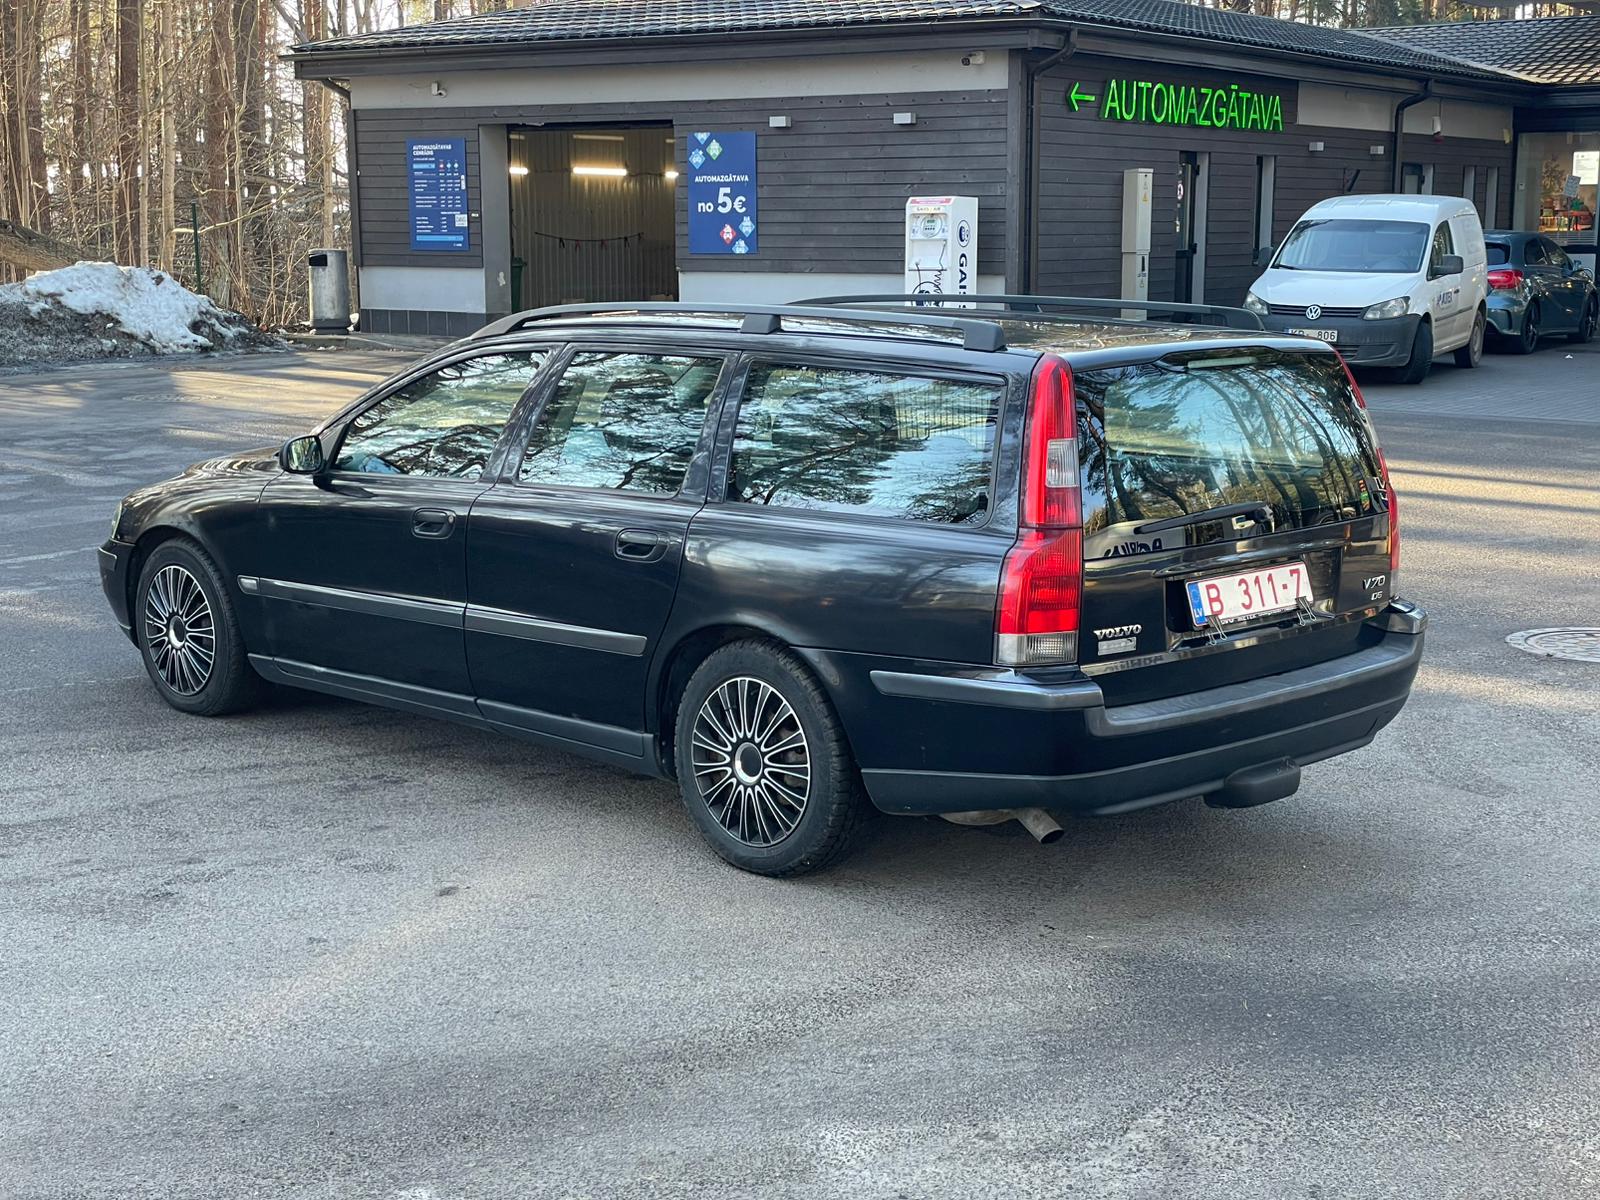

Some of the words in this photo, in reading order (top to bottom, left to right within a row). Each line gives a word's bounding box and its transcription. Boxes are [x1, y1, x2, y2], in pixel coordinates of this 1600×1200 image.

[1104, 79, 1283, 131] AUTOMAZGĀTAVA
[695, 173, 749, 183] AUTOMAZGĀTAVA
[697, 202, 714, 213] no
[1364, 574, 1385, 589] V70
[1205, 583, 1224, 616] B
[1238, 568, 1301, 610] 311-7
[1093, 624, 1142, 640] VOLVO
